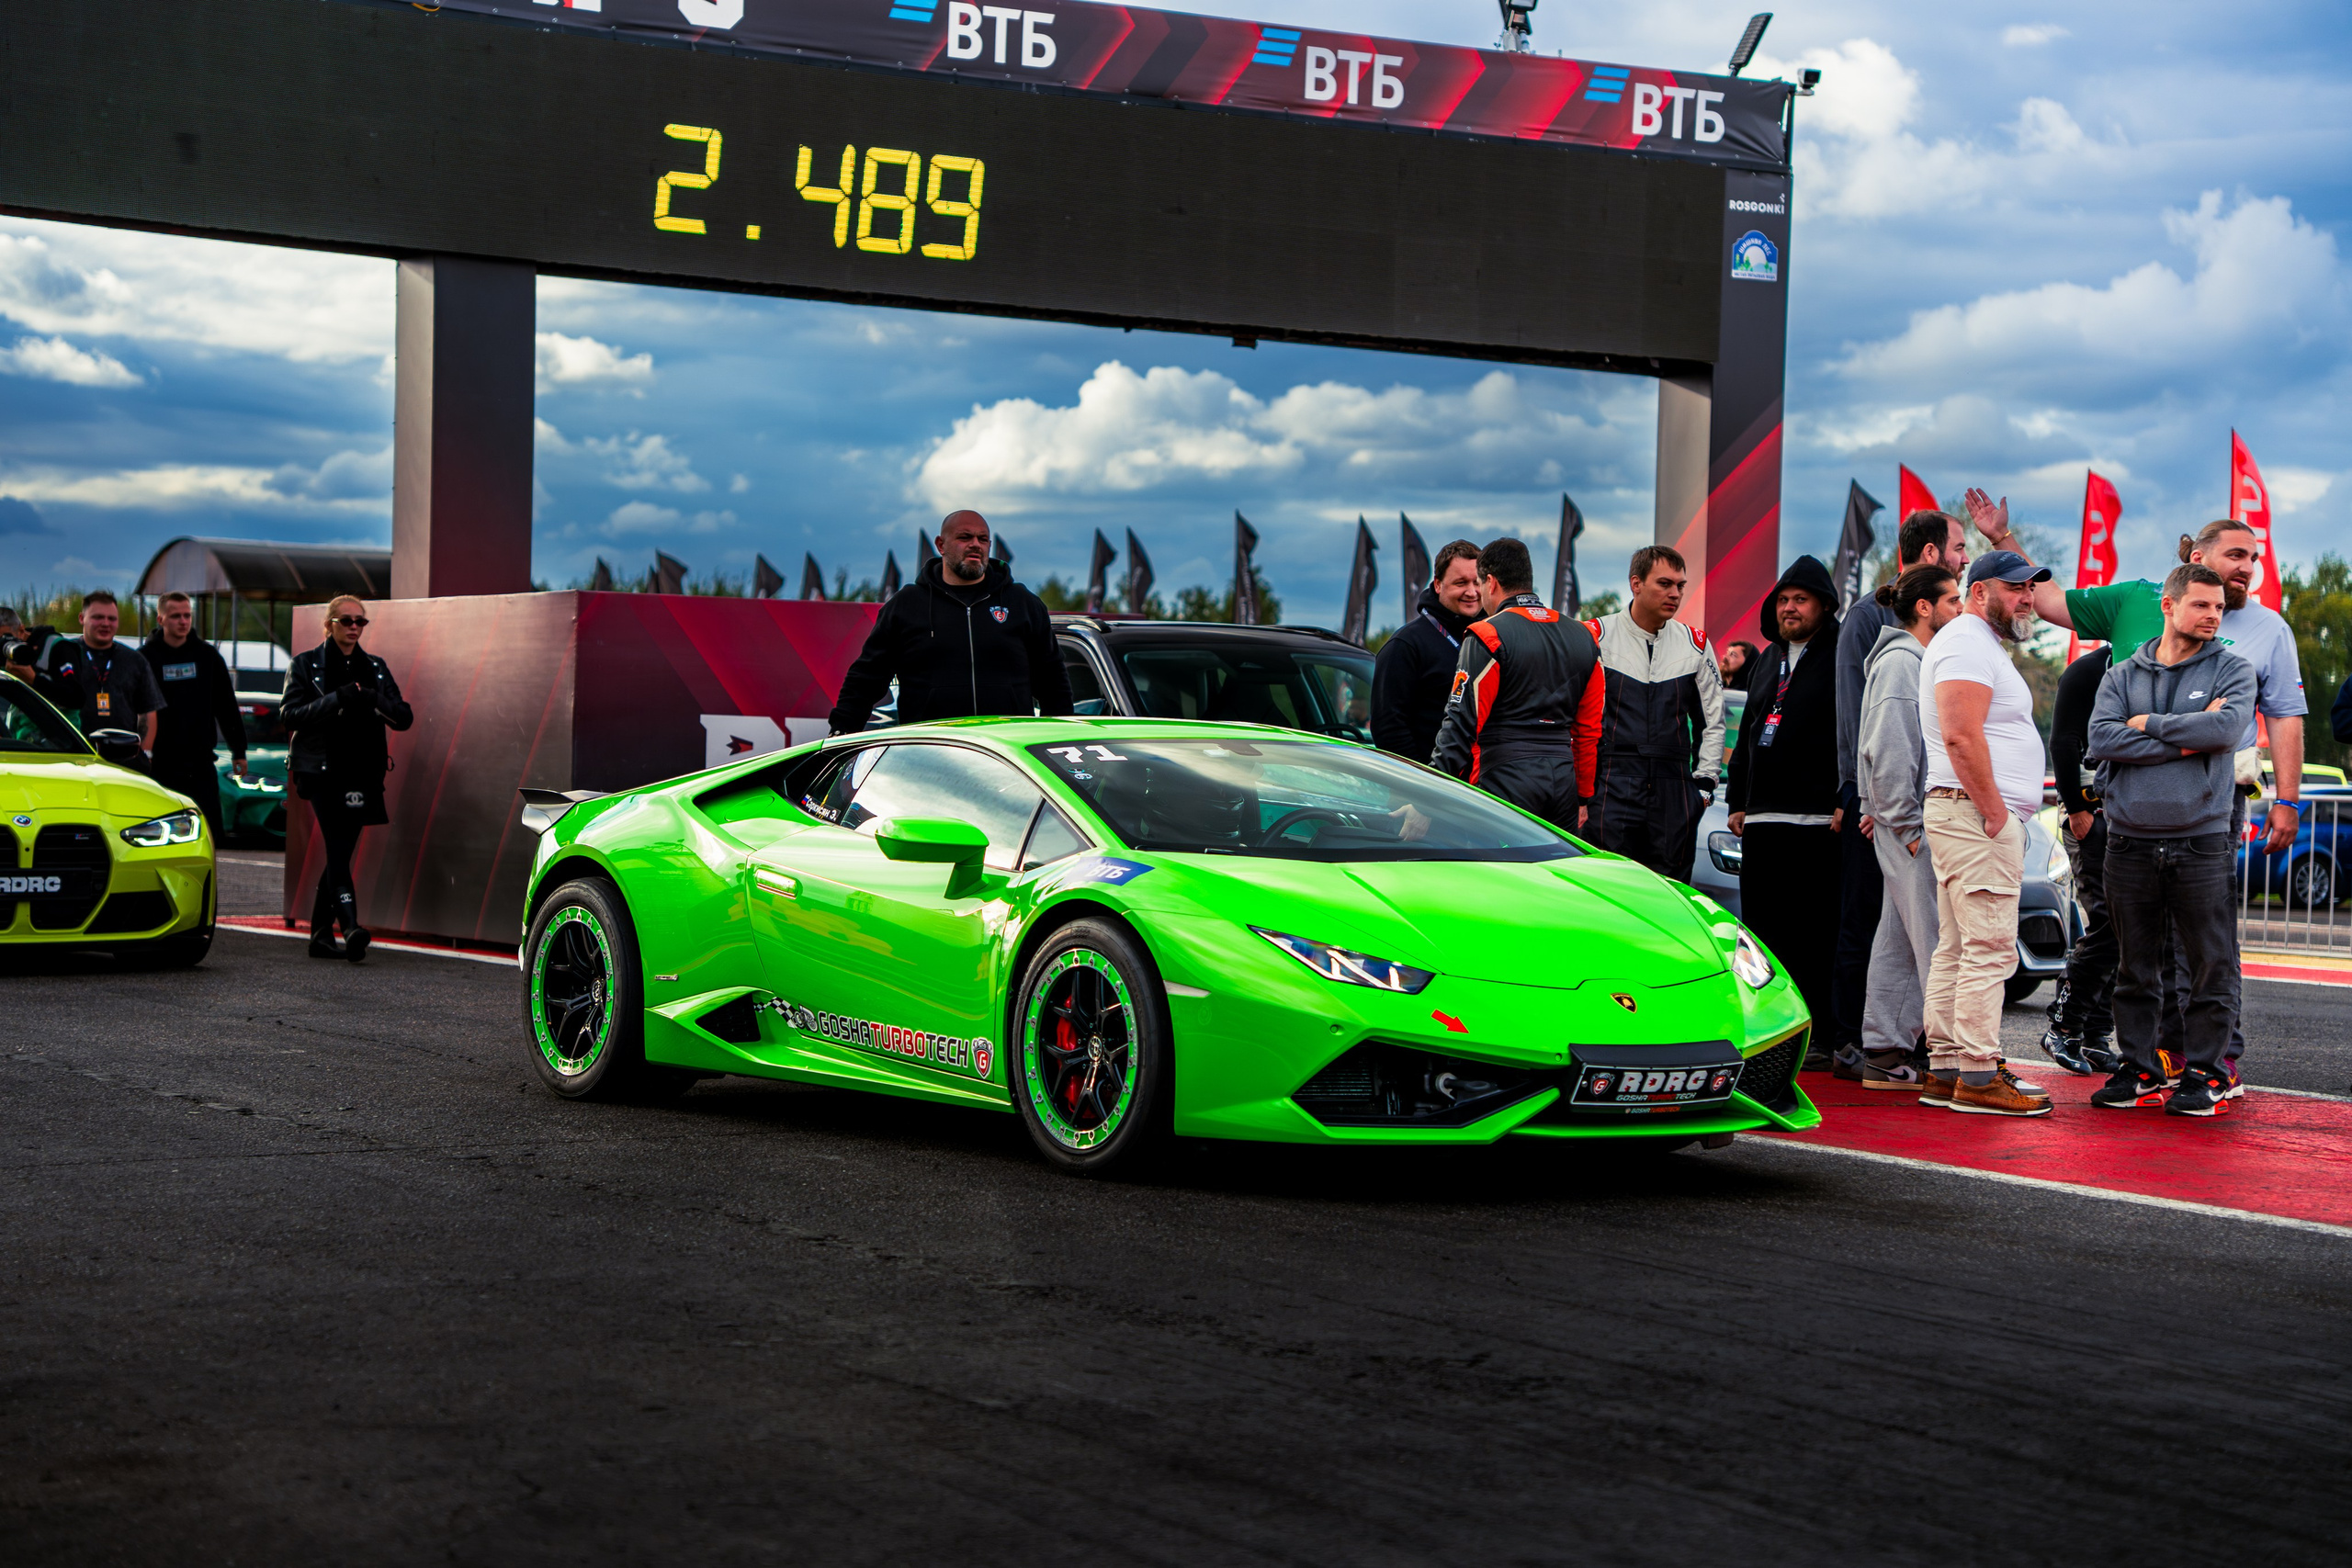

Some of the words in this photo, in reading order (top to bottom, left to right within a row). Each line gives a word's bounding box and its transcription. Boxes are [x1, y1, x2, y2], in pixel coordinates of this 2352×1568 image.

[947, 0, 1057, 69] ВТБ
[1304, 46, 1405, 108] ВТБ
[1632, 83, 1725, 143] ВТБ
[653, 123, 985, 261] 2.489
[1729, 199, 1785, 214] ROSGONKI
[1046, 745, 1128, 763] 71
[1085, 864, 1131, 879] ВТБ
[818, 1011, 969, 1068] GOSHATURBOTECH
[1618, 1070, 1707, 1092] RDRC
